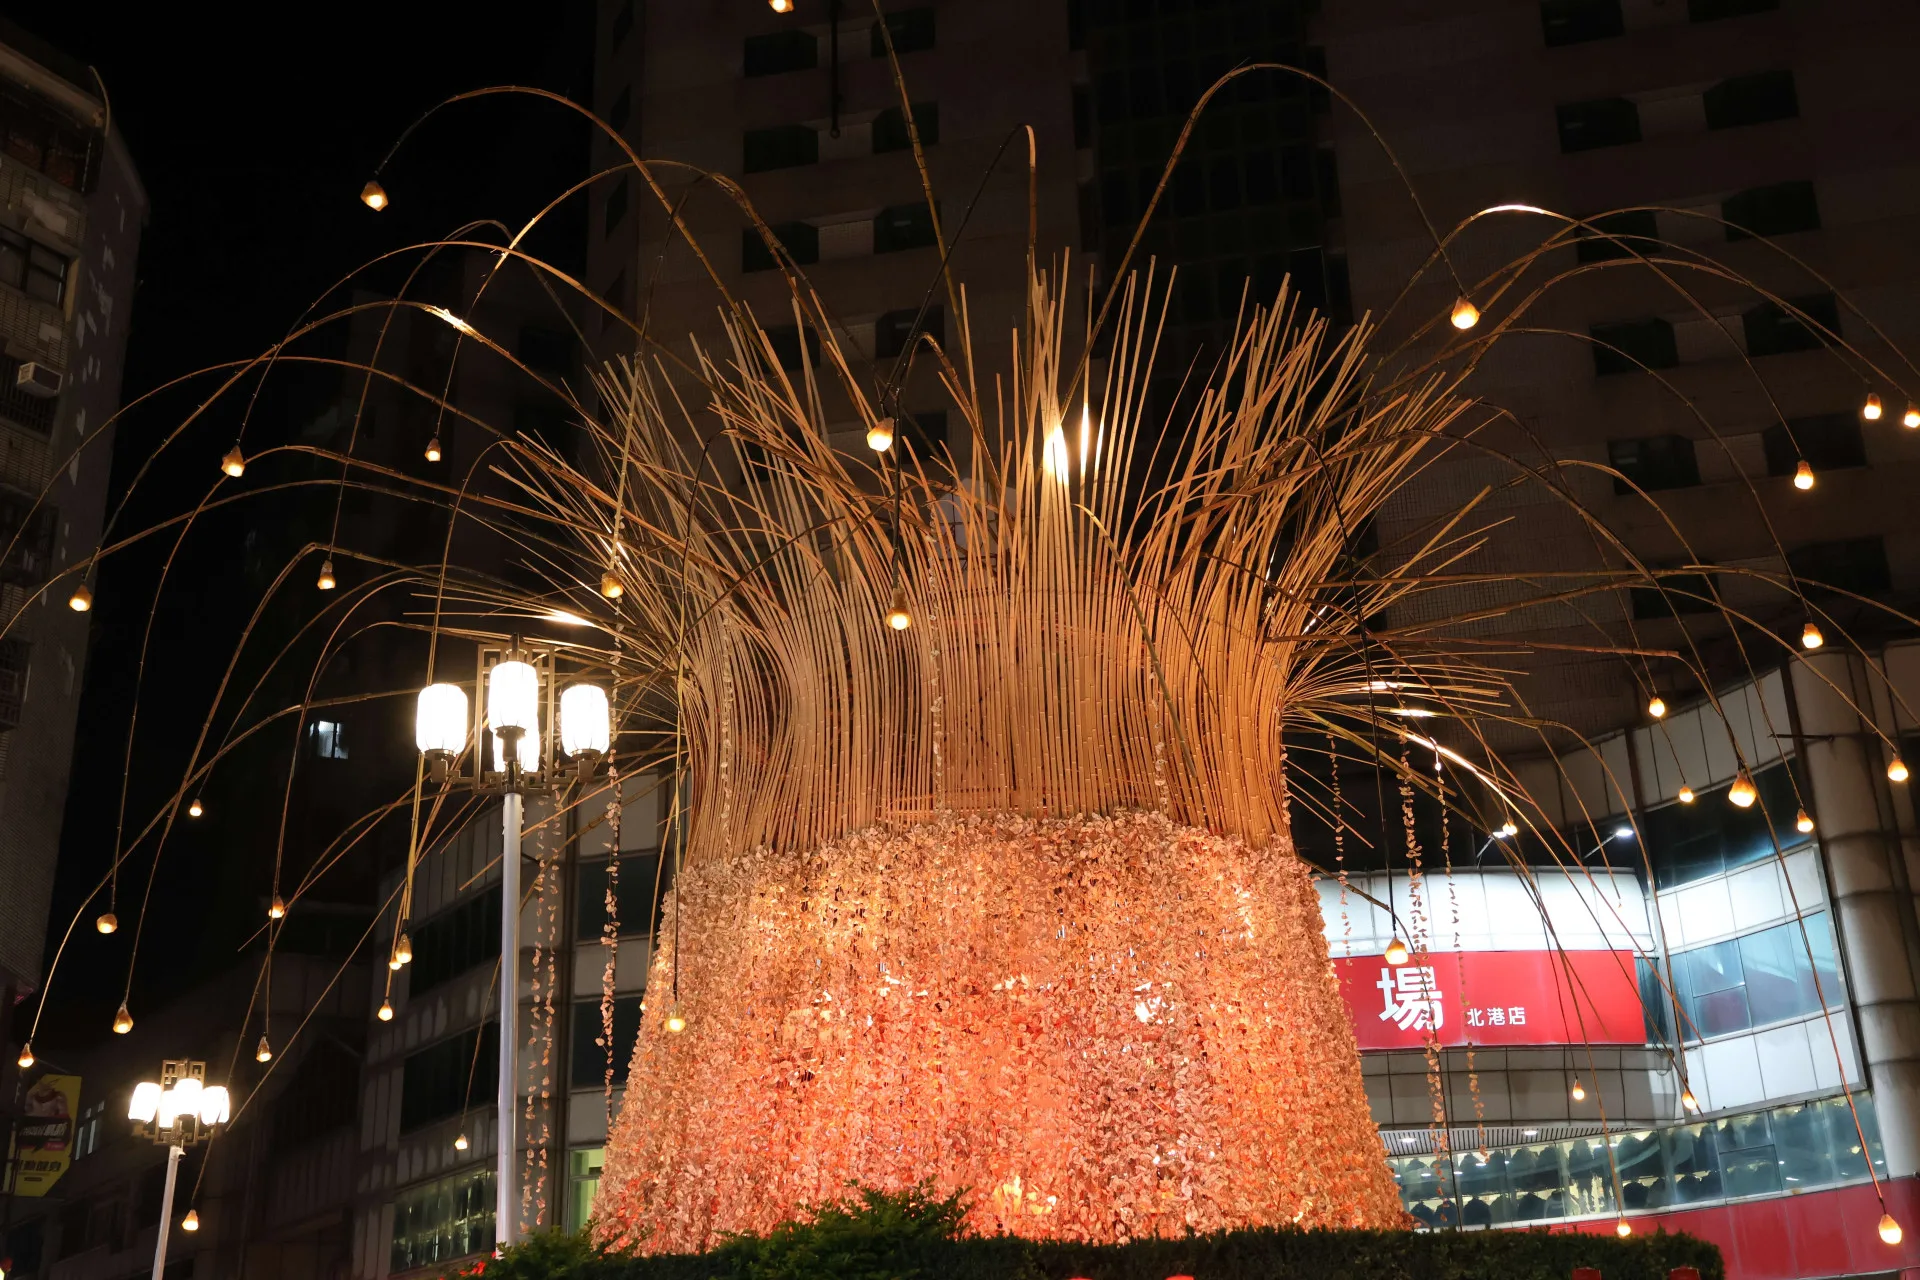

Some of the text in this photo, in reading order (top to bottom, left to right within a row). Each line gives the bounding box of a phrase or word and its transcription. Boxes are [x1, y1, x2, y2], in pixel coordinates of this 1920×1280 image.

[1376, 966, 1444, 1031] 場
[1467, 1006, 1526, 1027] 北港店
